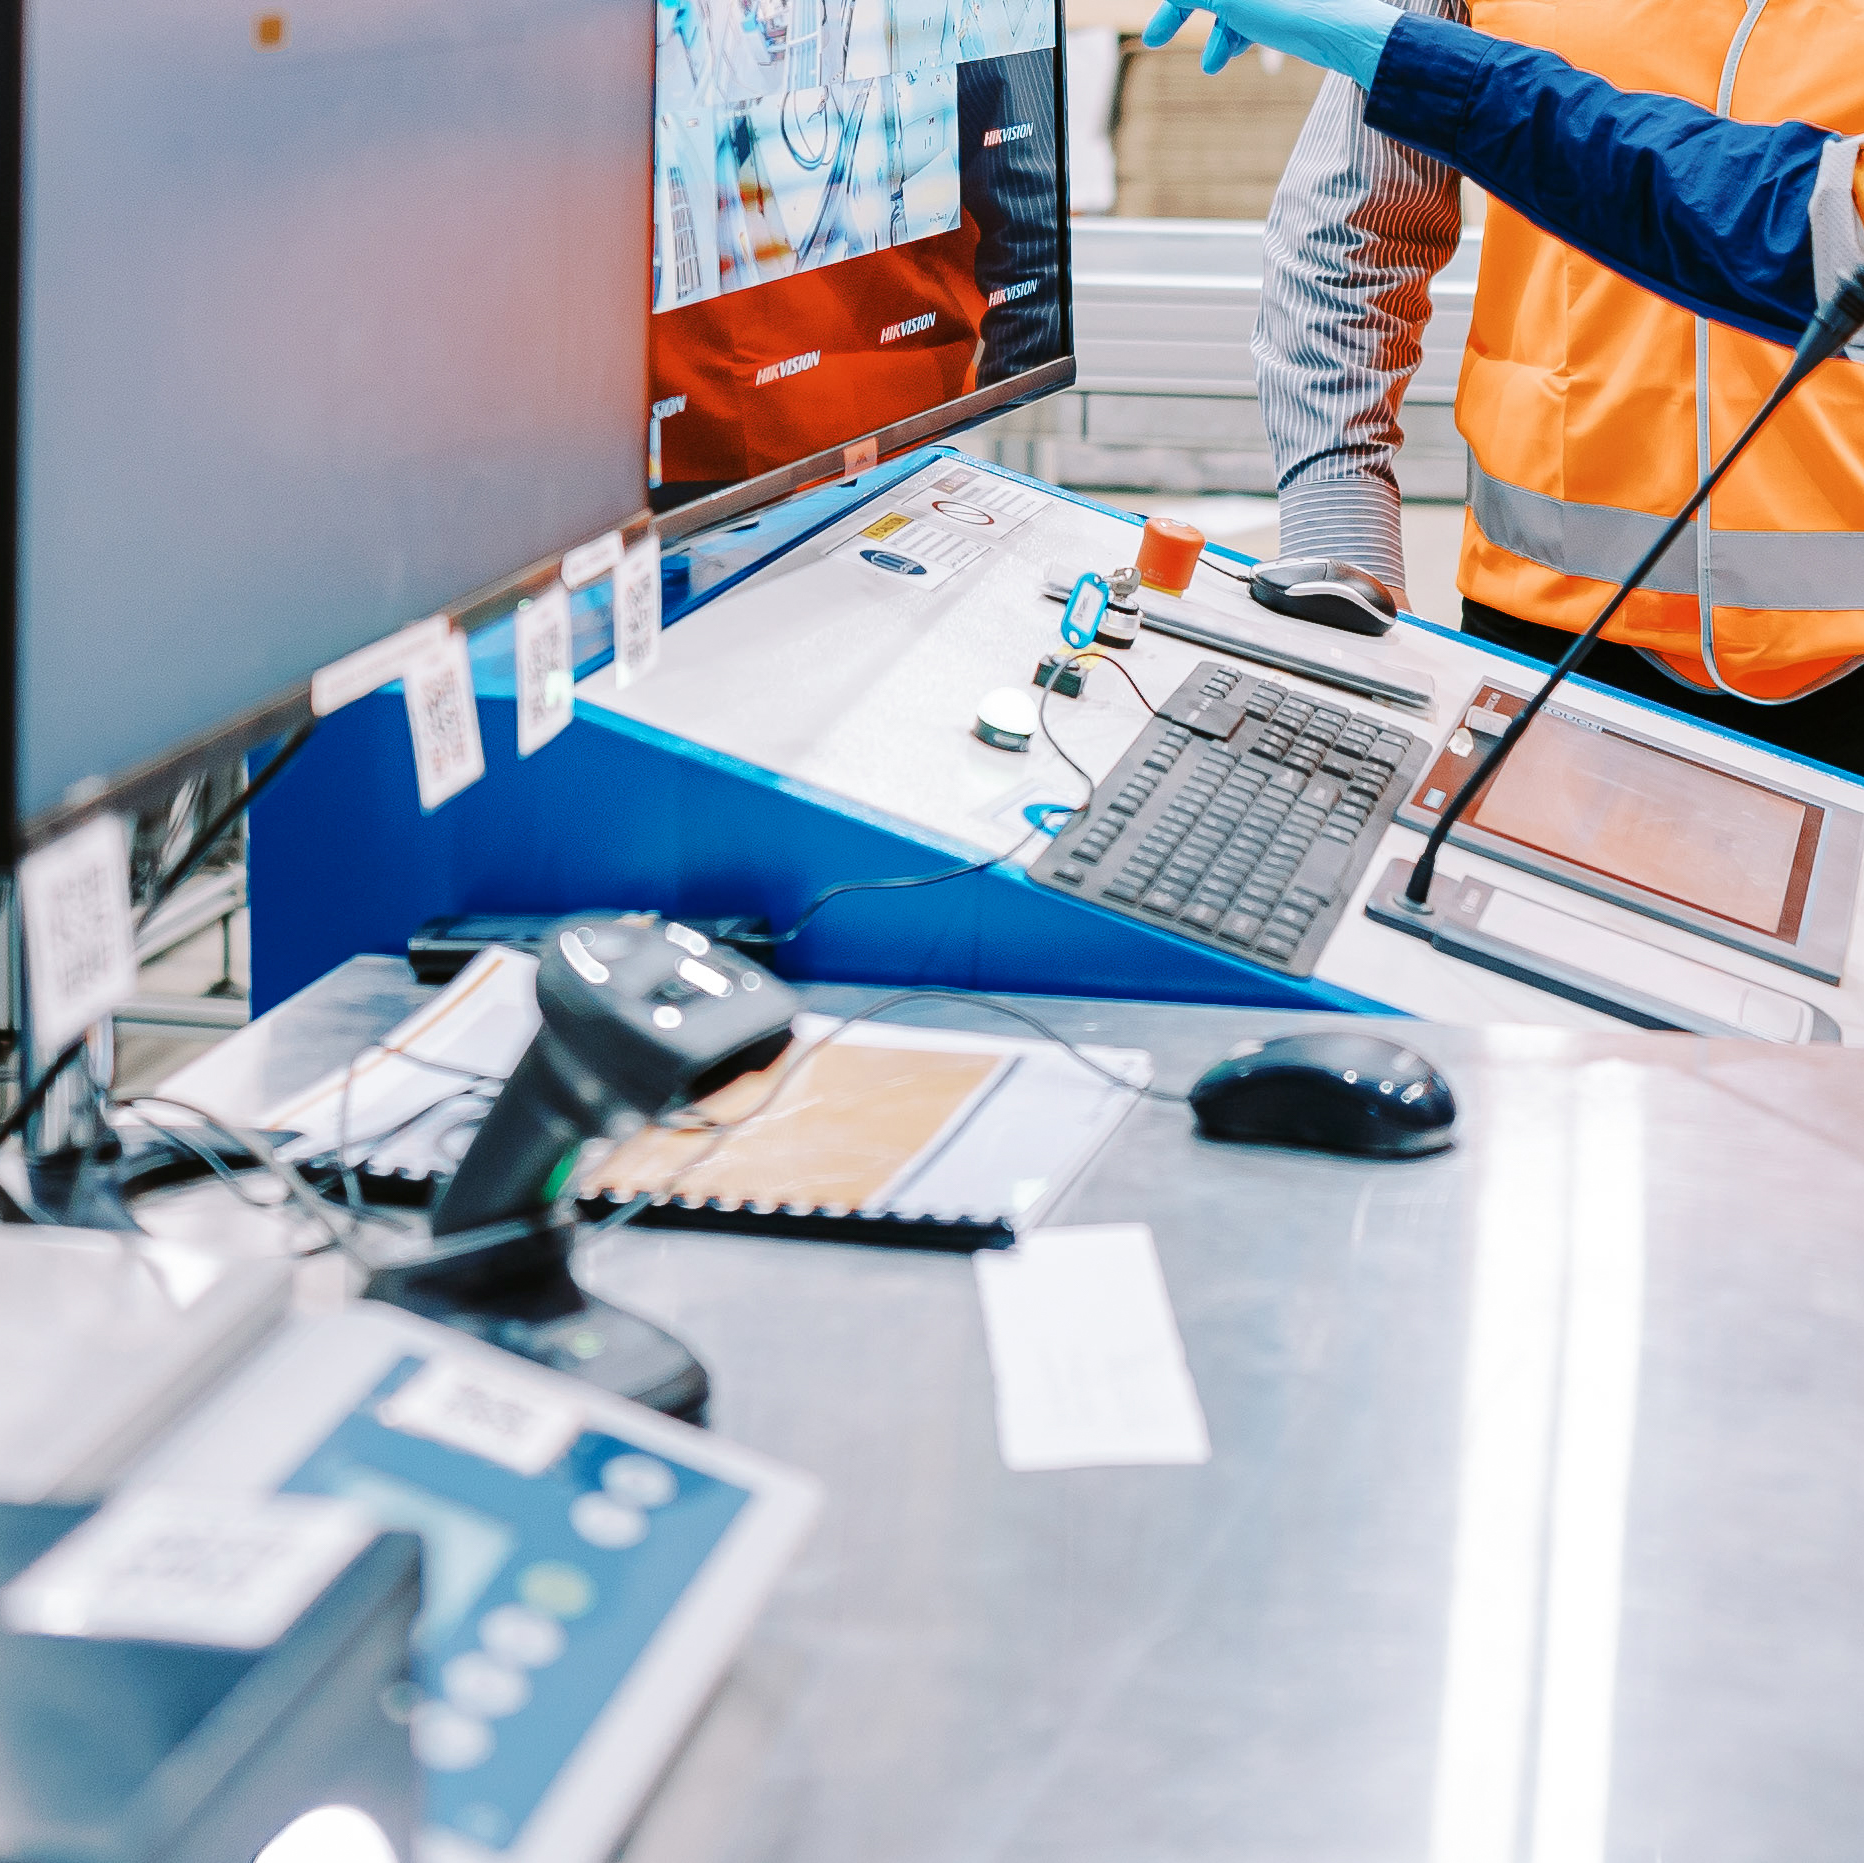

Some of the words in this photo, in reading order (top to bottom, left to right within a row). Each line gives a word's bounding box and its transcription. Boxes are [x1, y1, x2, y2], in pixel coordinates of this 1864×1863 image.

[983, 122, 1034, 147] HIKVISION
[988, 279, 1038, 307] HIKVISION
[880, 311, 936, 344] HIKVISION
[755, 349, 821, 387] HIKVISION
